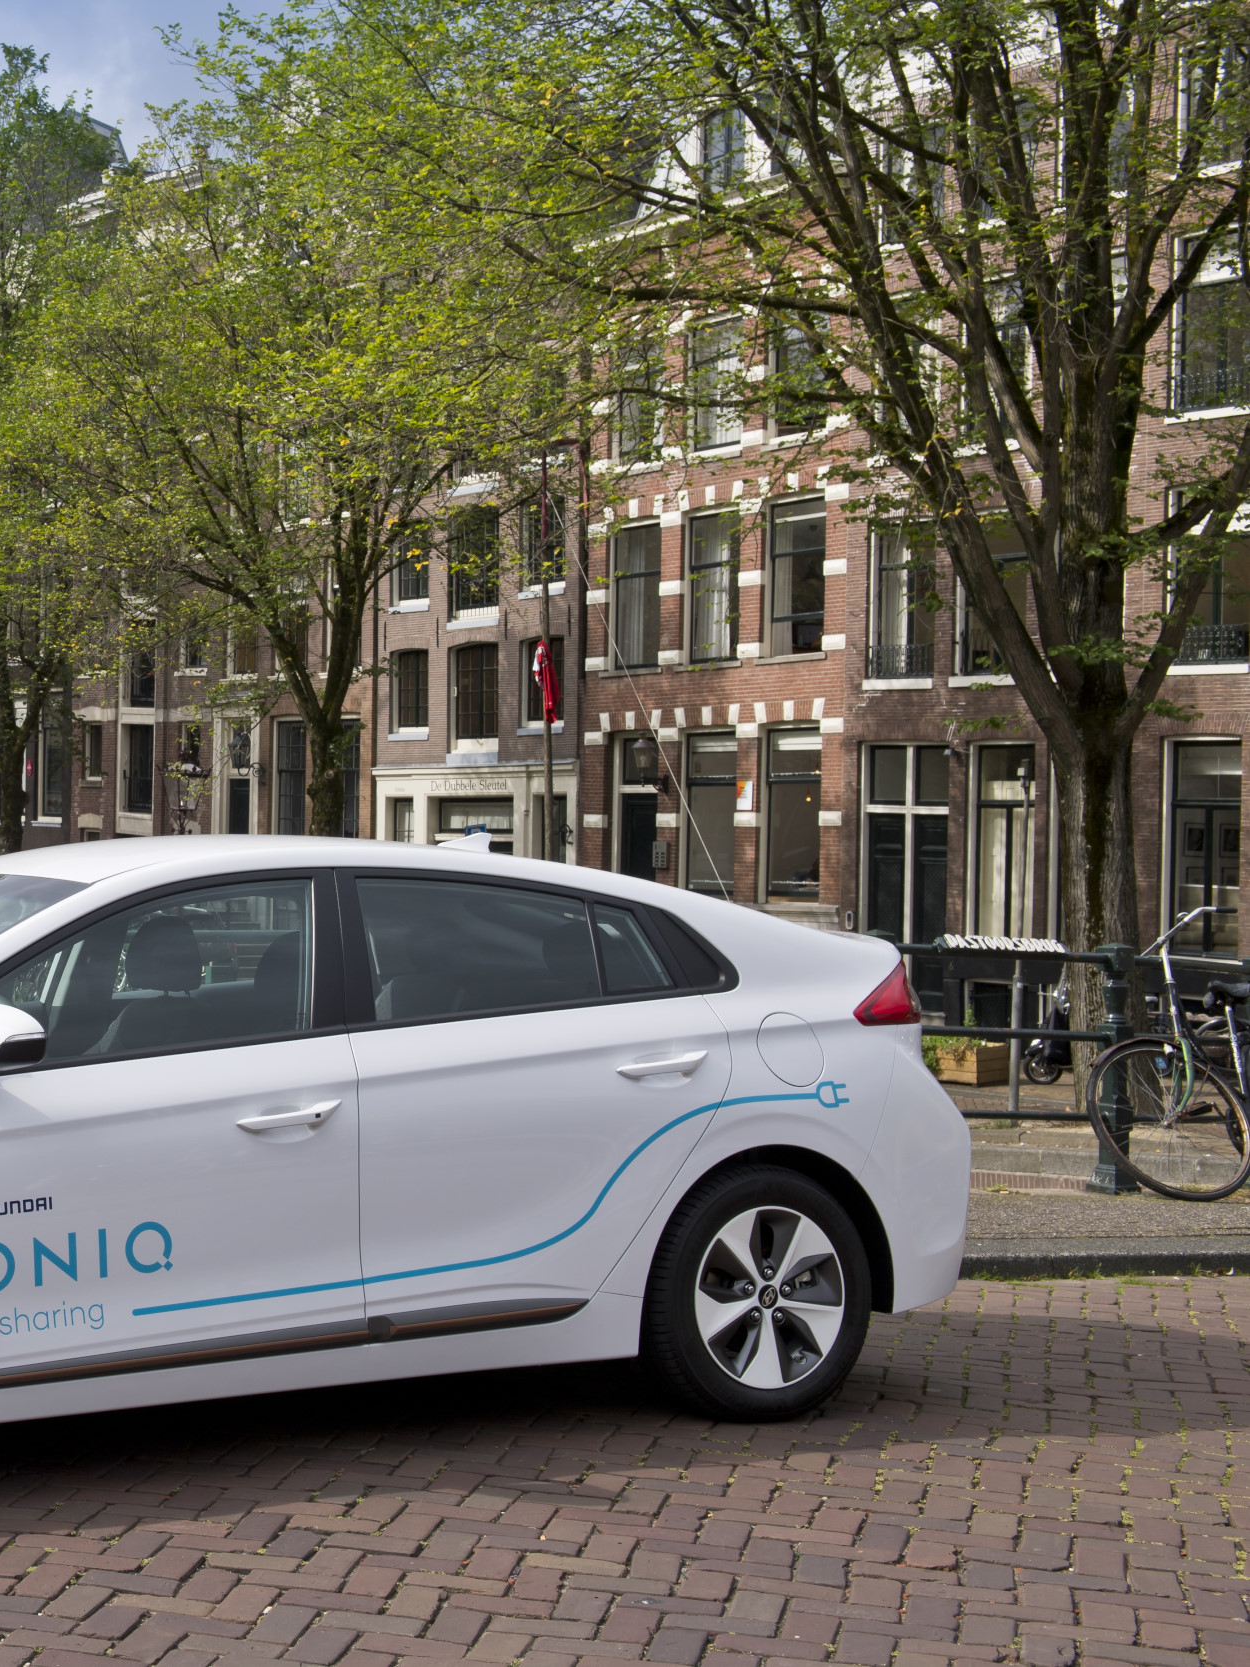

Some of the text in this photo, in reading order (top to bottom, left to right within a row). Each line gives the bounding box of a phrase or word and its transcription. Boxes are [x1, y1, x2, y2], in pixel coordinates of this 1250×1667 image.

[431, 779, 507, 792] De Dubbele Sleutel
[943, 933, 1066, 953] PASTOORSBRUG
[0, 1301, 105, 1336] sharing
